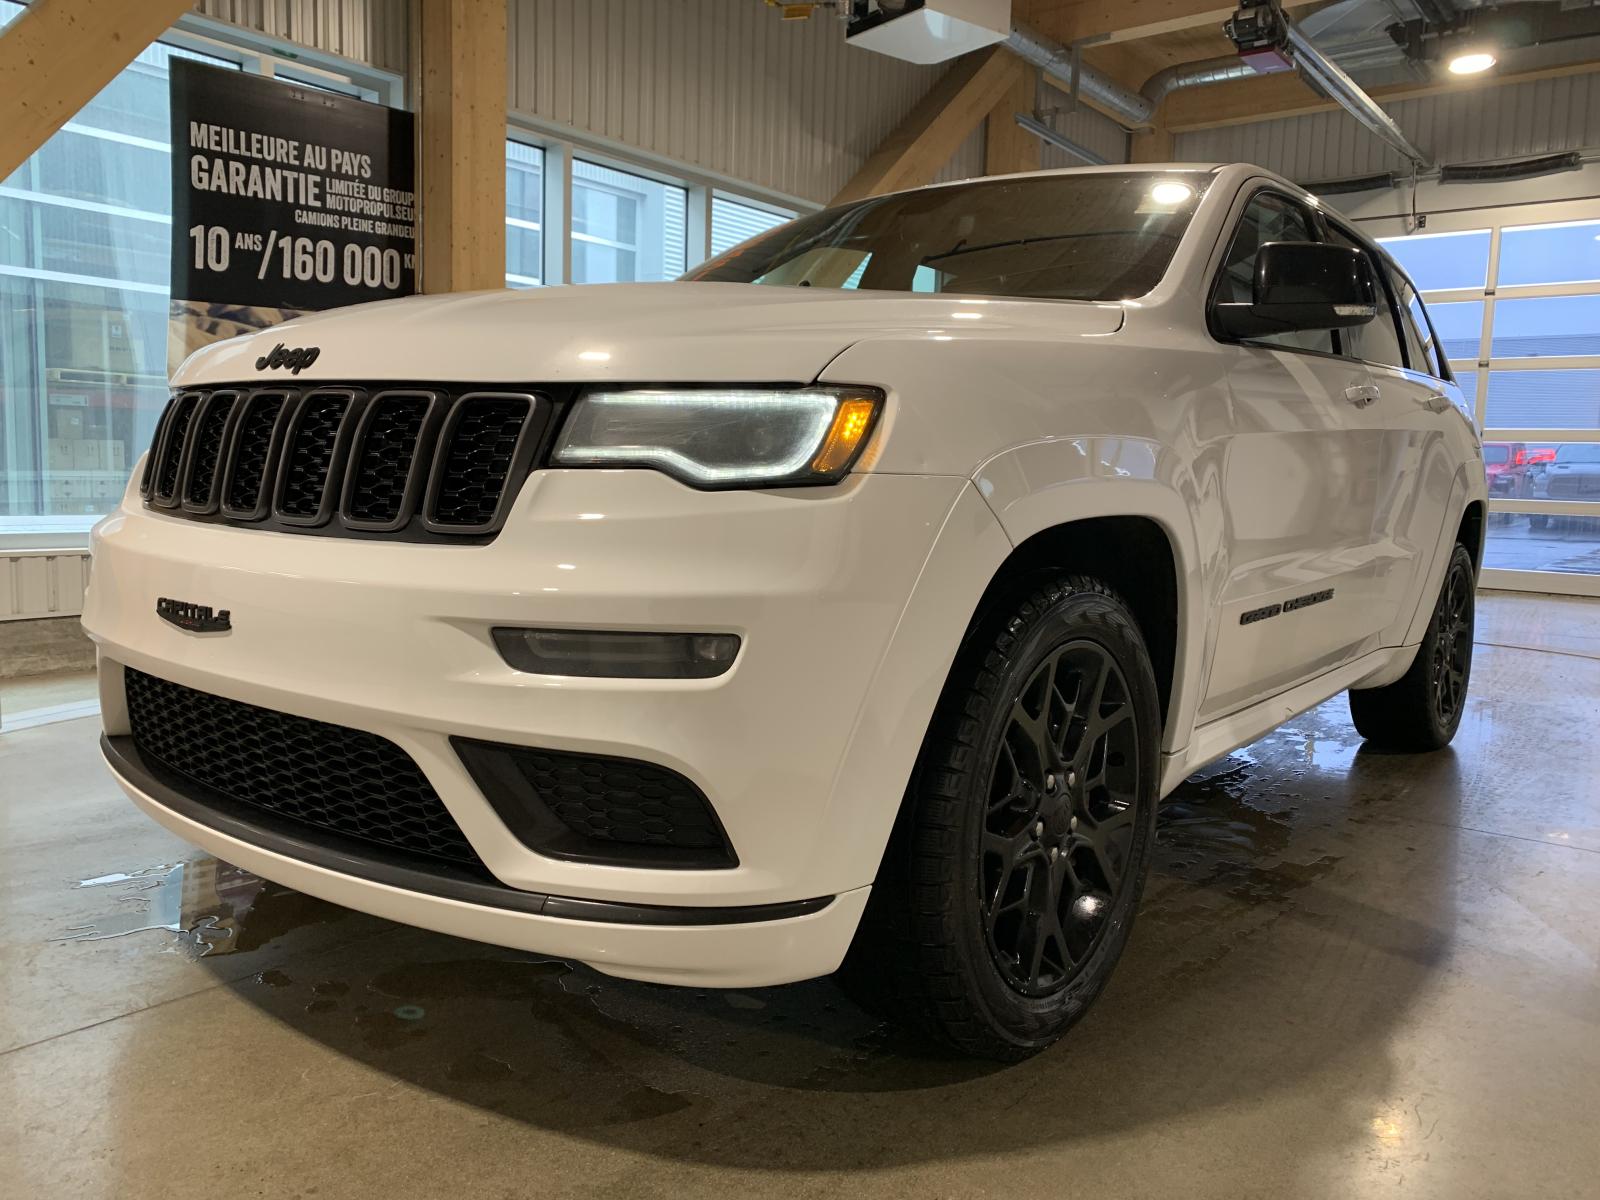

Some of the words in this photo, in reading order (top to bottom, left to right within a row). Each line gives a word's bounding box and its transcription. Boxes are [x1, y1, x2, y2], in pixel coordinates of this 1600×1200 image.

[190, 121, 299, 166] MEILLEURE
[303, 144, 326, 170] AU
[331, 149, 372, 179] PAYS
[191, 155, 322, 208] GARANTIE
[326, 177, 366, 199] LIMITÉE
[368, 185, 382, 201] DU
[383, 187, 415, 207] GROUP
[326, 193, 415, 222] MOTOPROPULSEU
[295, 209, 340, 229] CAMIONS
[341, 216, 374, 234] PLEINE
[375, 221, 415, 240] GRANDEU
[190, 224, 230, 273] 10
[235, 231, 262, 251] ANS
[343, 243, 400, 290] 000
[255, 342, 320, 375] Jeep
